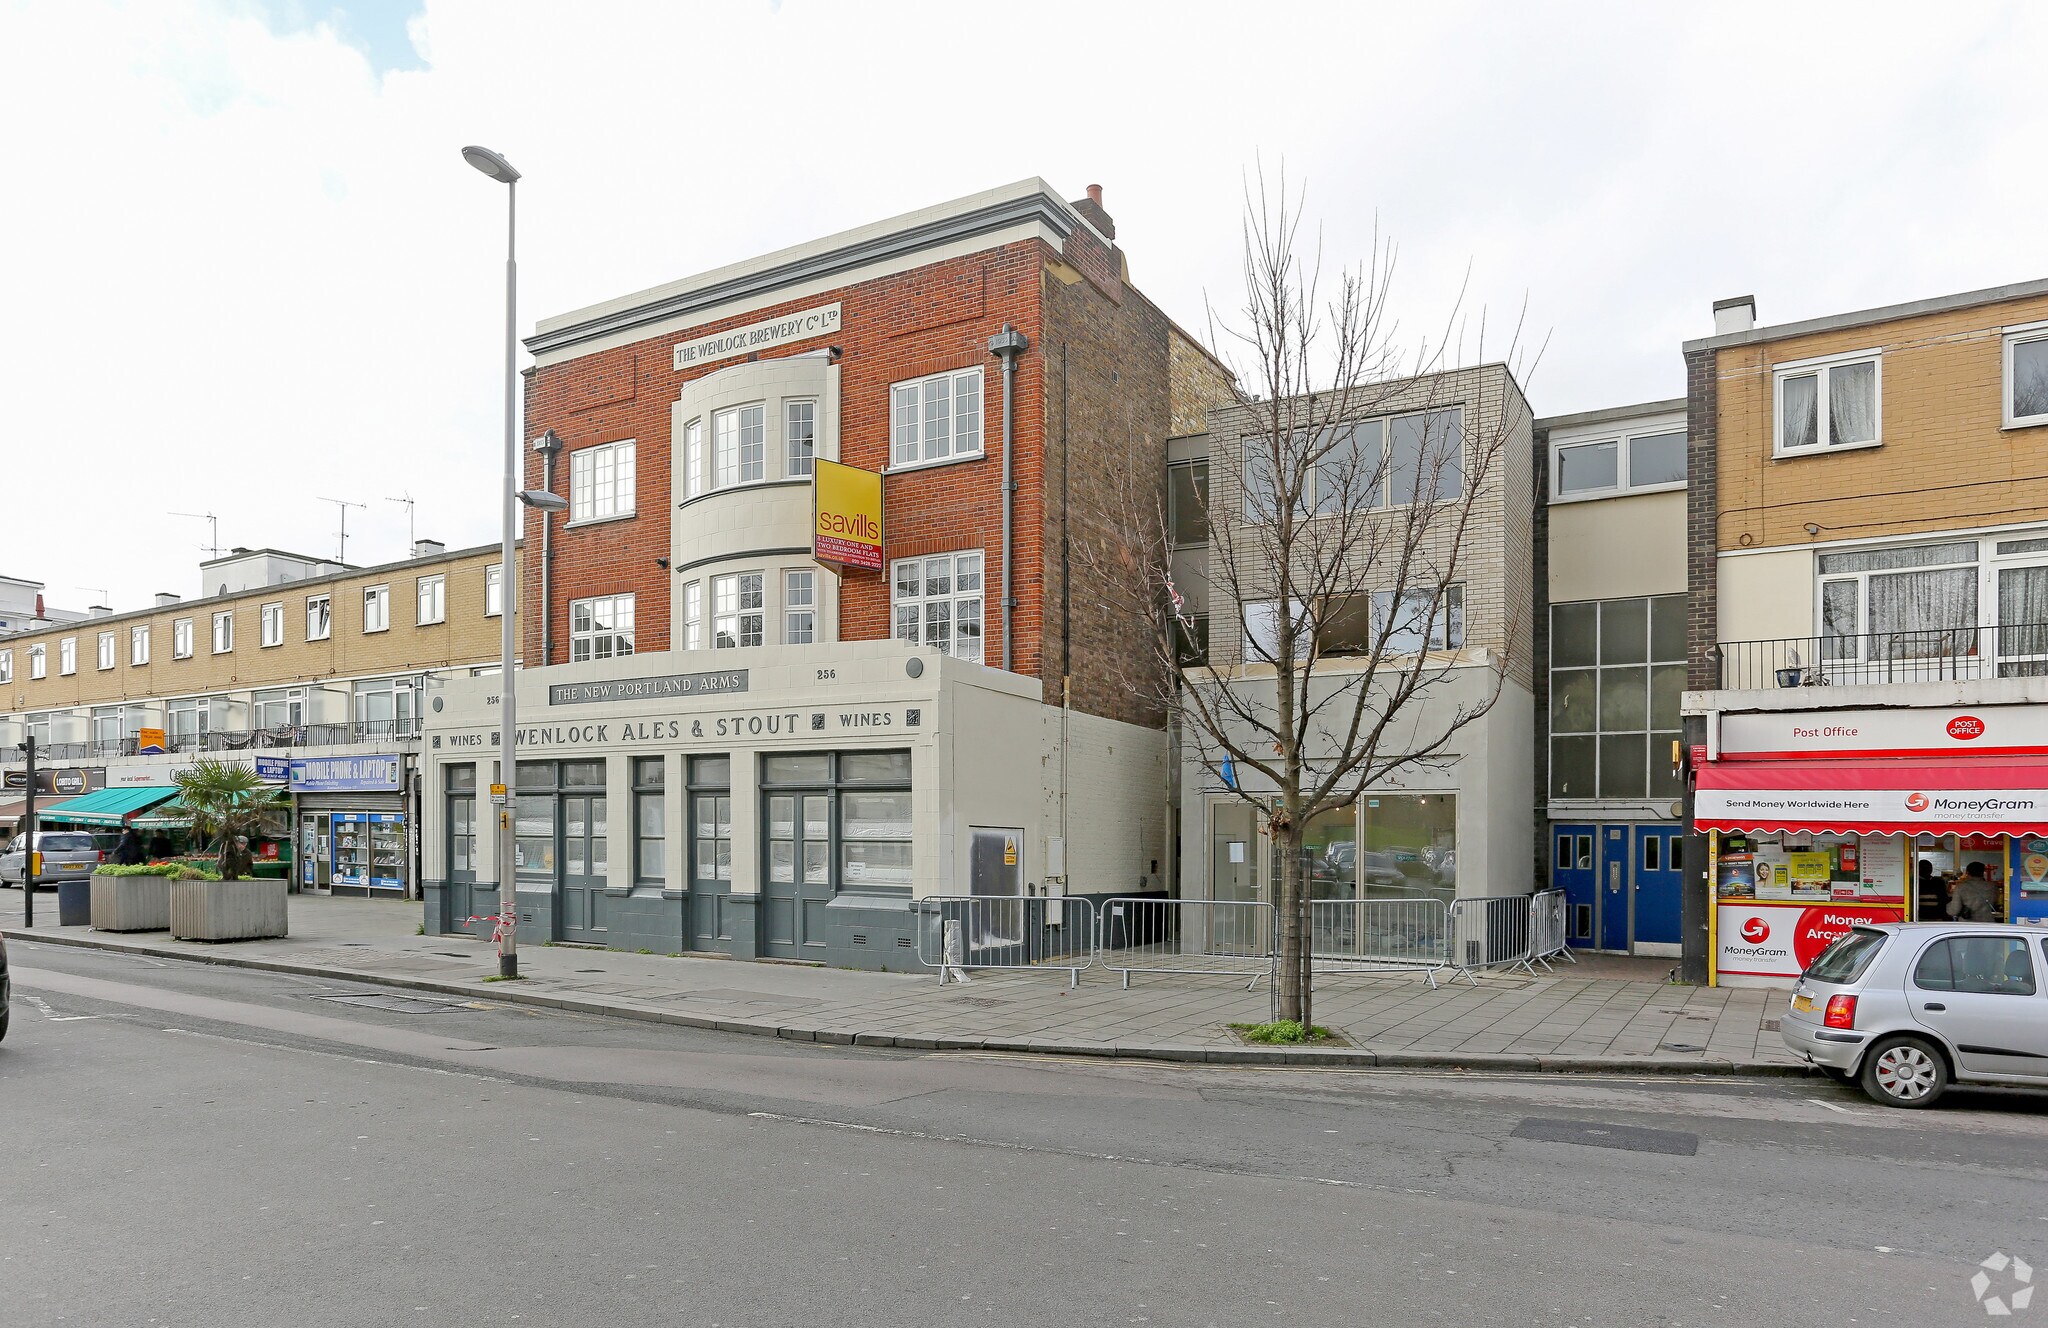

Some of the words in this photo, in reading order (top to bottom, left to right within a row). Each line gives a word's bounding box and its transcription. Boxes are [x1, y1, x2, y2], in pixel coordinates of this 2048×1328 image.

[676, 346, 696, 364] THE
[698, 332, 748, 358] WENLOCK
[749, 318, 804, 346] BREWERY
[819, 512, 879, 540] savills
[822, 537, 846, 546] LUXURY
[846, 539, 860, 548] ONE
[861, 543, 873, 551] AND
[832, 545, 861, 554] BEDROOM
[862, 549, 880, 559] FLATS
[816, 669, 837, 680] 256
[556, 688, 578, 701] THE
[584, 685, 612, 699] NEW
[617, 679, 692, 696] PORTLAND
[700, 675, 740, 691] ARMS
[486, 696, 500, 705] 256
[839, 712, 892, 727] WINES
[1955, 720, 1977, 728] POST
[514, 724, 609, 746] WENLOCK
[622, 720, 679, 741] ALES
[691, 719, 704, 738] &
[716, 714, 799, 736] STOUT
[1793, 728, 1819, 738] Post
[1823, 727, 1859, 737] Office
[1950, 727, 1980, 735] OFFICE
[449, 734, 482, 747] WINES
[306, 761, 330, 780] MOBILE
[330, 760, 353, 780] PHONE
[353, 762, 359, 779] &
[360, 759, 386, 779] LAPTOP
[1726, 800, 1751, 808] Send
[1752, 800, 1785, 809] Money
[1787, 800, 1842, 809] Worldwide
[1843, 801, 1870, 809] Here
[1934, 798, 2034, 812] MoneyGram
[1824, 914, 1873, 926] Money
[1724, 946, 1787, 957] MoneyGram
